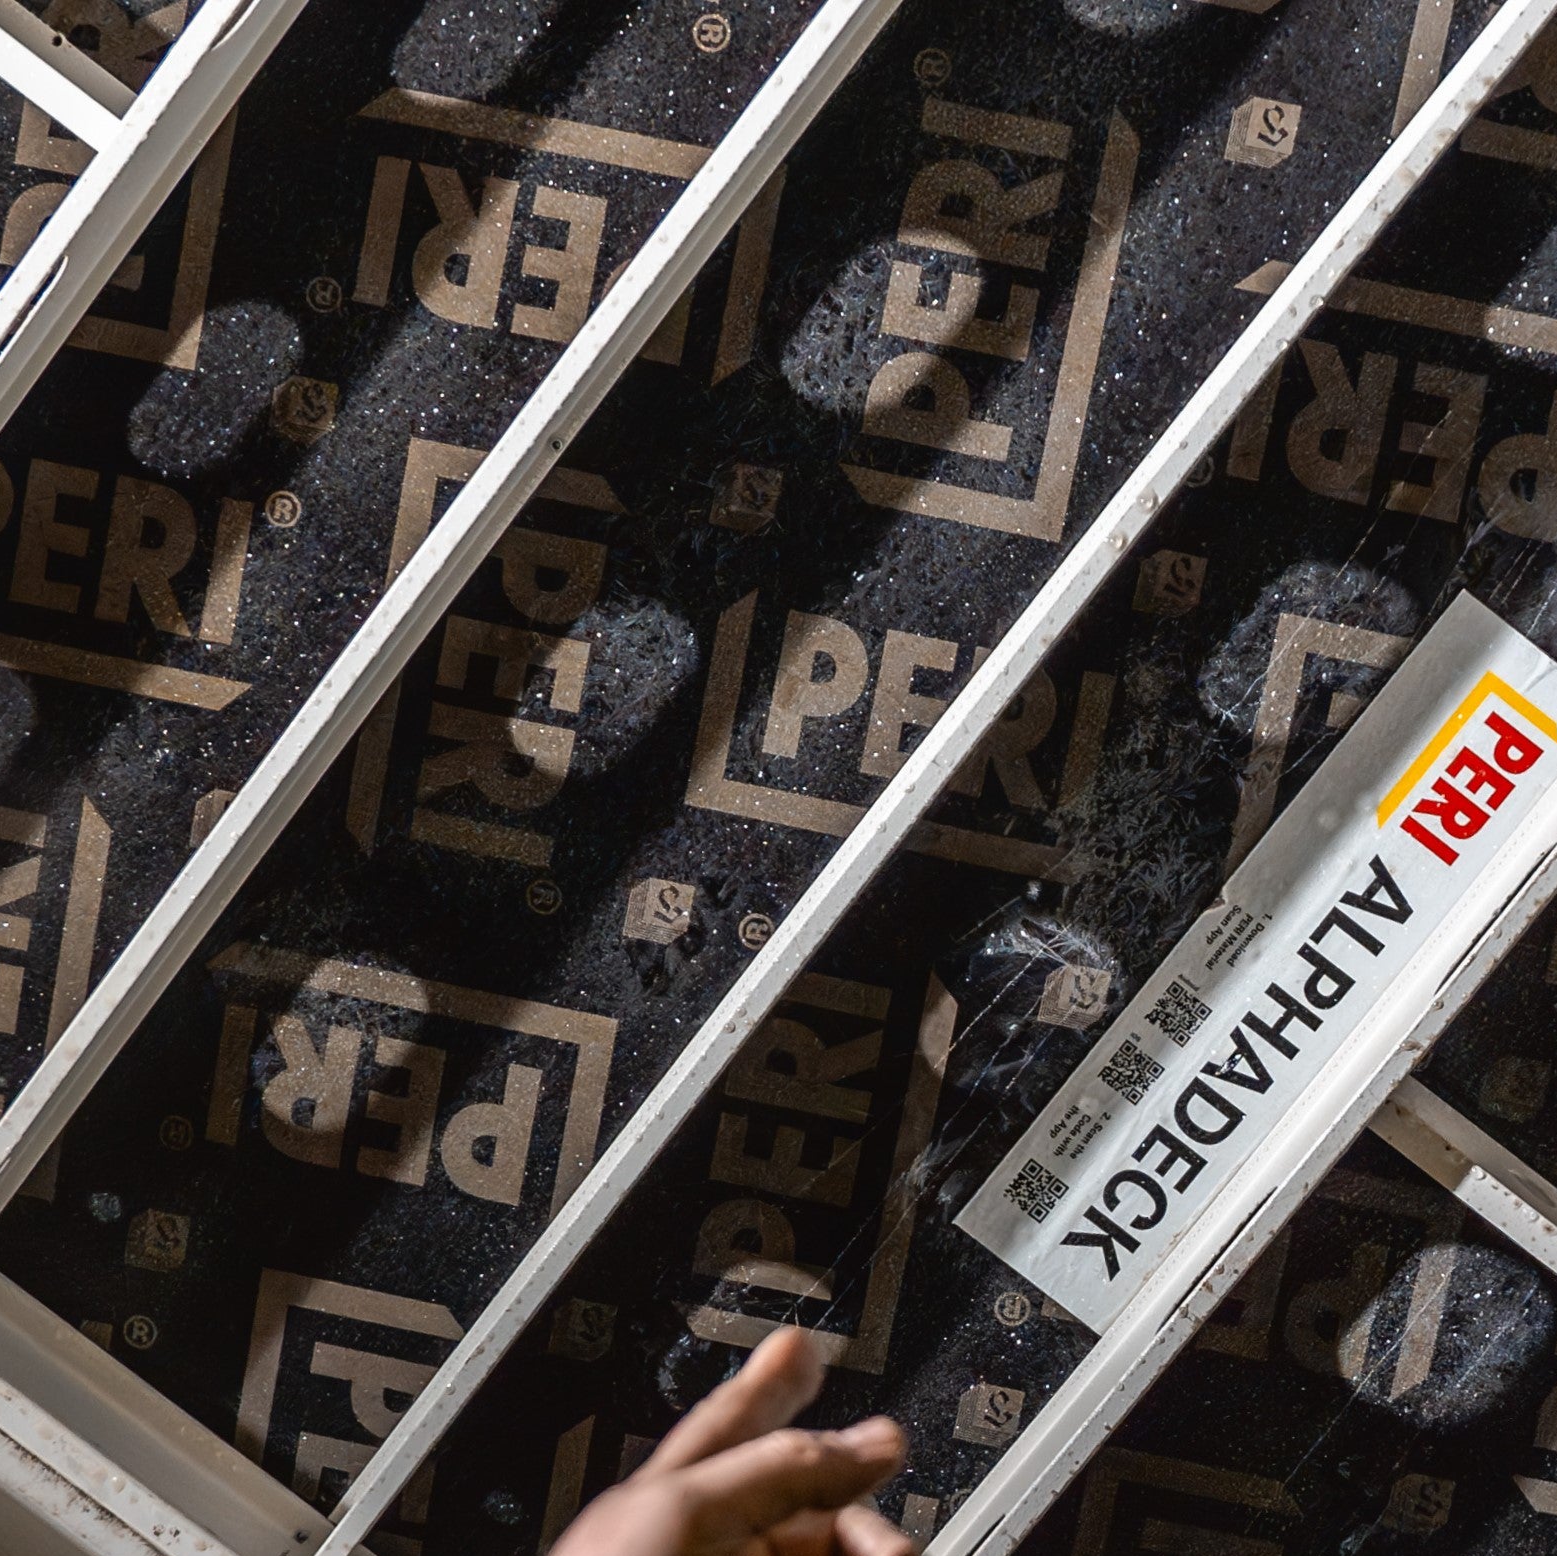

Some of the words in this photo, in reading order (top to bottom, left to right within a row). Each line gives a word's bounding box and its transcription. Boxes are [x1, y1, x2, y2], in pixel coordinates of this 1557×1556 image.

[860, 95, 1075, 462] PERI
[408, 526, 609, 870] PERI
[1401, 712, 1543, 866] PERI
[1220, 904, 1242, 926] Scan
[1233, 913, 1253, 935] PERI
[1205, 925, 1223, 945] App
[1226, 922, 1265, 967] Download
[1205, 933, 1237, 970] Material
[1059, 853, 1414, 1282] ALPHADECK
[204, 1004, 545, 1208] PERI
[692, 971, 894, 1301] PERI
[1049, 1119, 1067, 1138] App
[1069, 1113, 1091, 1136] Code
[1080, 1122, 1103, 1144] Scan
[1053, 1136, 1072, 1156] with
[1069, 1143, 1084, 1159] the
